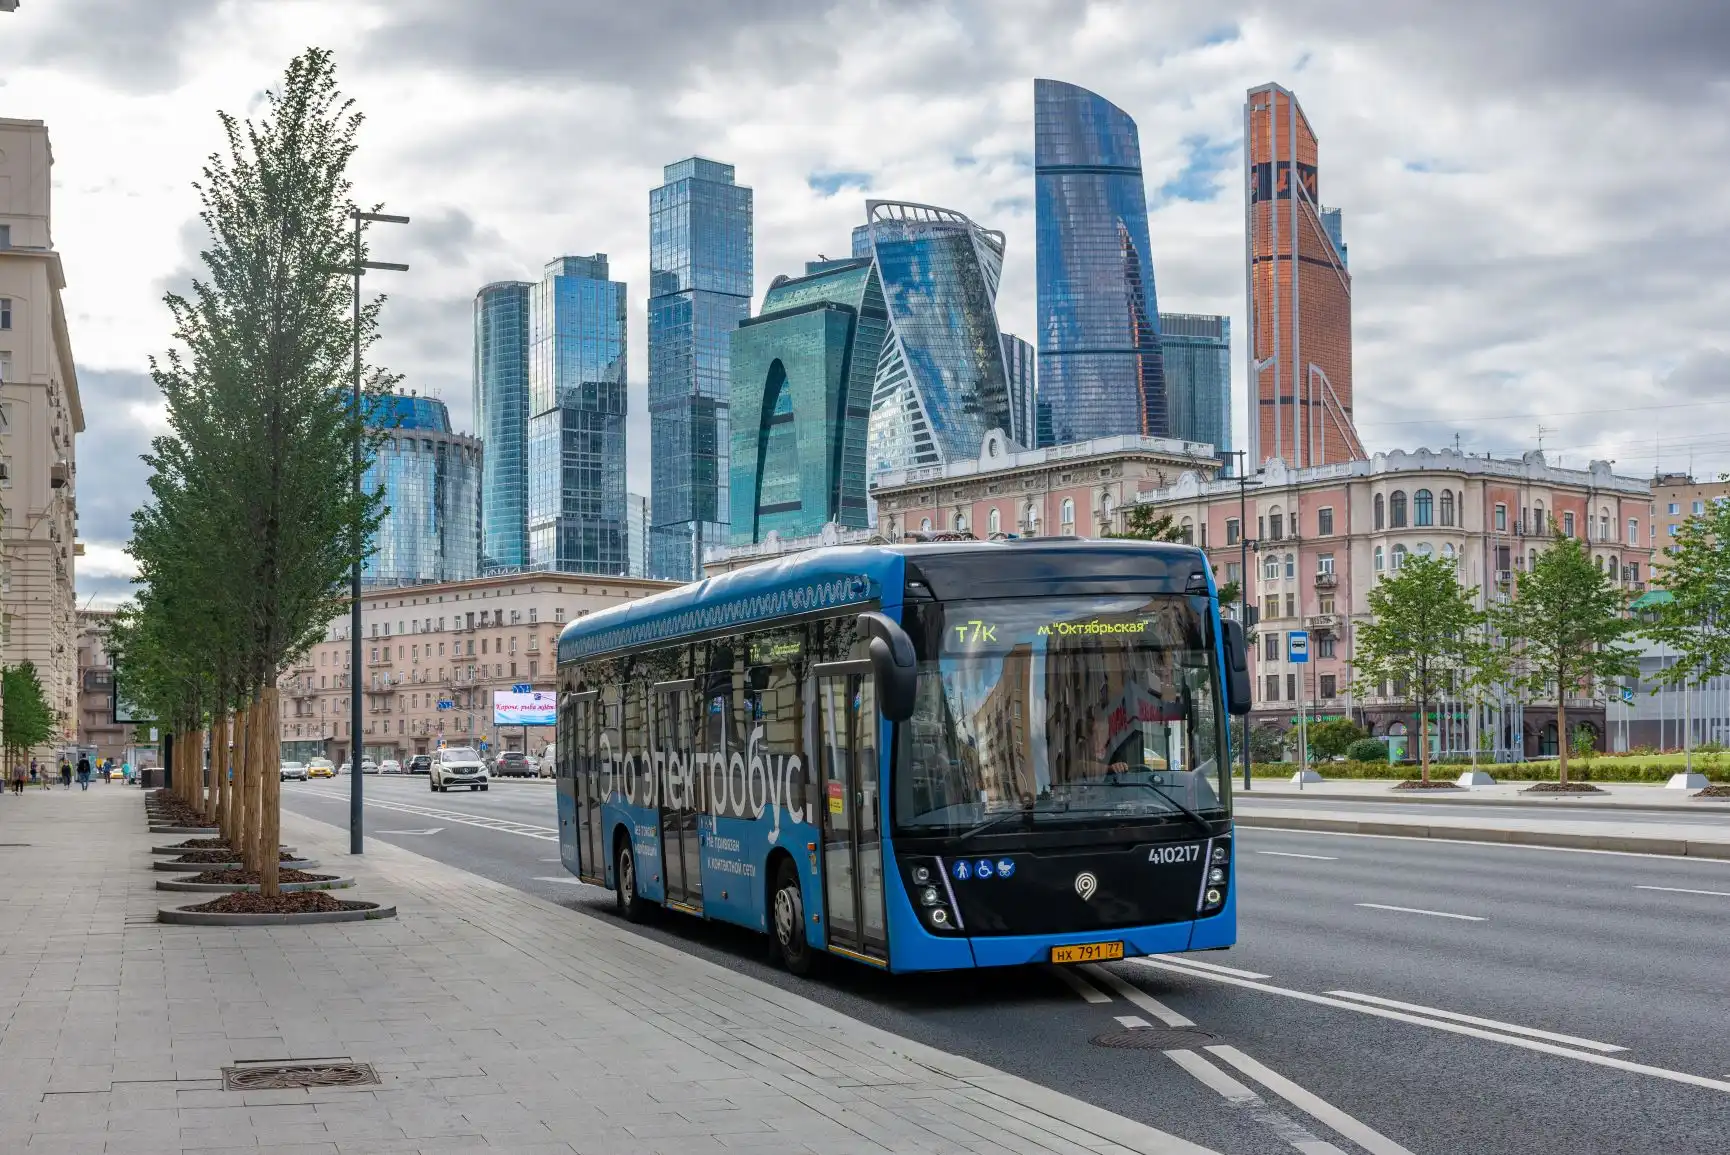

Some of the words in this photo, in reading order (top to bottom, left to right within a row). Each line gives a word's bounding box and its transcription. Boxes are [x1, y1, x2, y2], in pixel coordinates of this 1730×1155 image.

[600, 731, 636, 804] Это
[641, 724, 813, 845] электробус.
[706, 831, 714, 848] Не
[714, 837, 740, 853] привязан
[1148, 844, 1200, 864] 410217
[712, 858, 742, 874] контактной
[743, 863, 756, 877] сети
[1078, 945, 1101, 960] 791
[1107, 943, 1120, 953] 77
